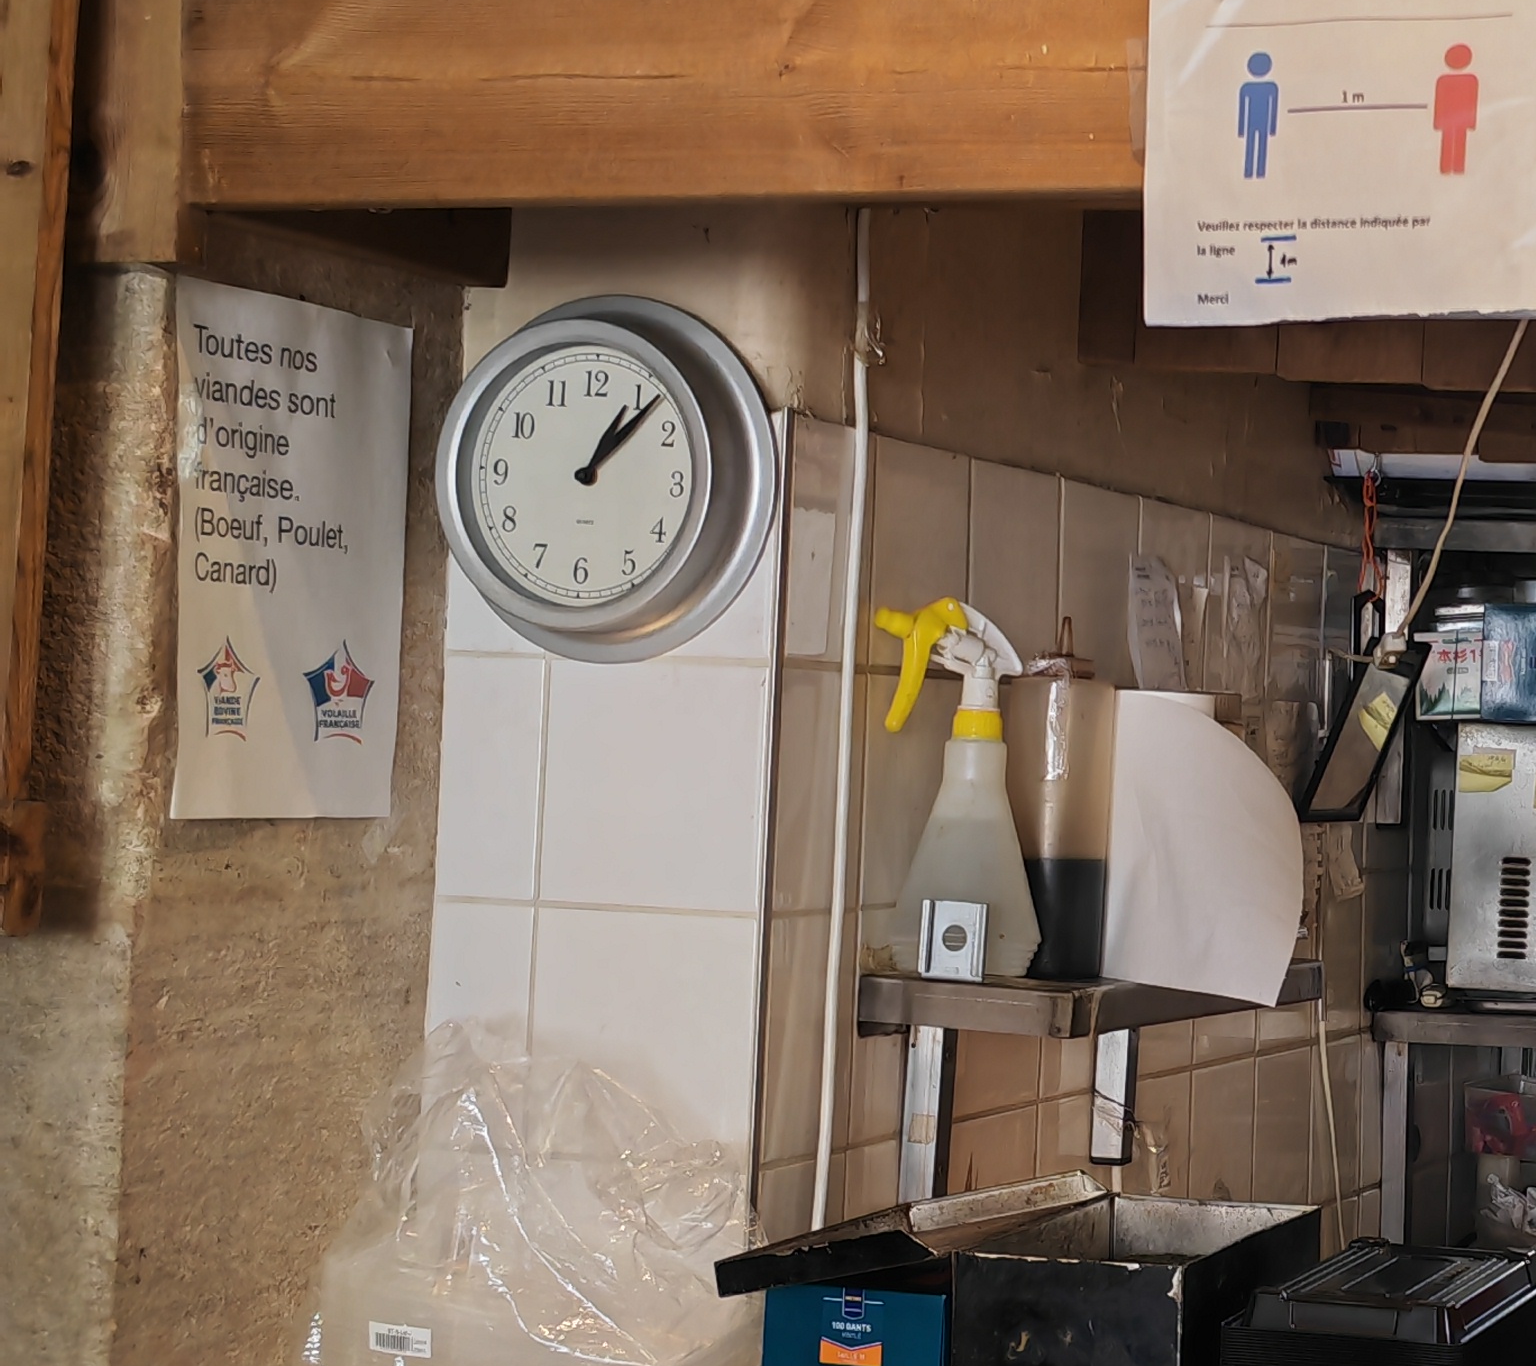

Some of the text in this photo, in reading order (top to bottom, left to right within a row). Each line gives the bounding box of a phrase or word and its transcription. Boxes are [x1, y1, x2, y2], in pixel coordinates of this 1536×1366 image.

[1197, 293, 1229, 305] Merci
[193, 323, 318, 373] Toutes nos
[194, 374, 336, 420] viandes sont
[545, 379, 568, 408] 11
[583, 370, 609, 398] 12
[633, 384, 643, 411] 1
[511, 411, 535, 440] 10
[660, 420, 676, 448] 2
[493, 458, 509, 486] 9
[669, 470, 684, 498] 3
[501, 505, 517, 533] 8
[649, 516, 667, 544] 4
[278, 516, 349, 554] Poulet,
[532, 542, 548, 570] 7
[621, 549, 637, 577] 5
[194, 552, 277, 594] Canard)
[572, 556, 589, 585] 6
